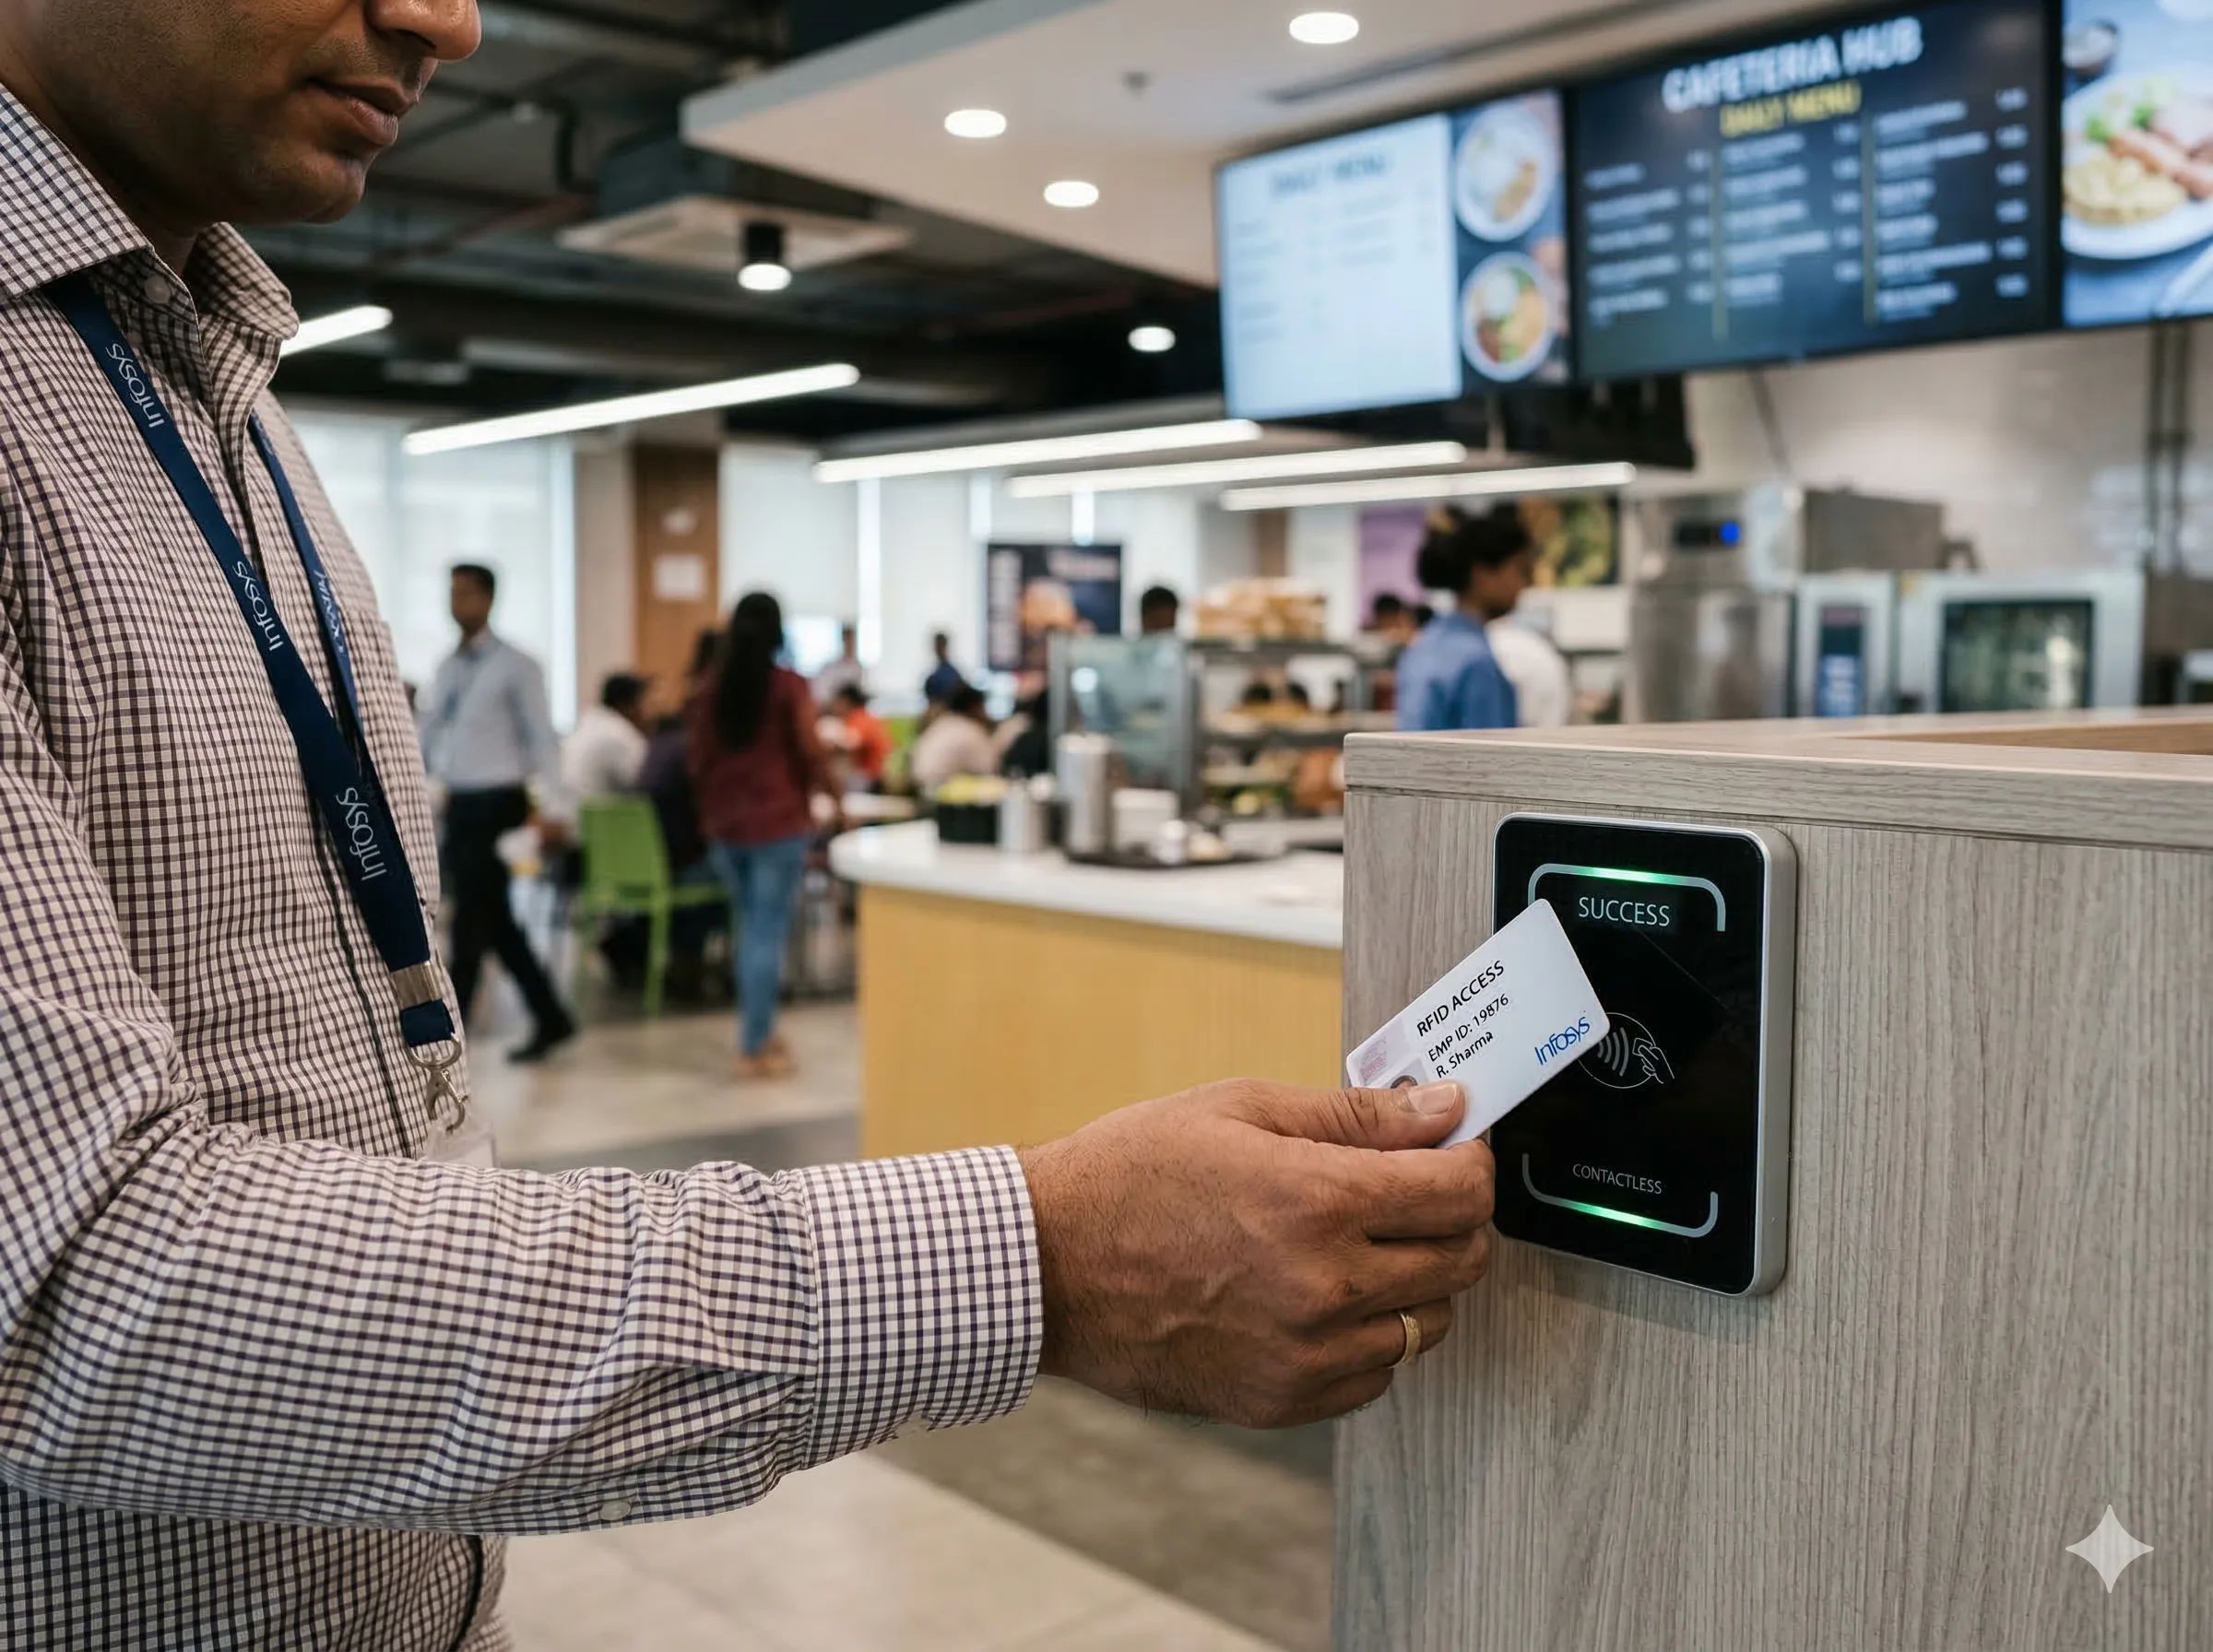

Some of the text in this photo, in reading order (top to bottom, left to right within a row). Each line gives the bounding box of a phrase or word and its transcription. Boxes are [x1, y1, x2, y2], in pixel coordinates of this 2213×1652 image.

[1663, 17, 1923, 112] CAFETERIA HUB
[1786, 78, 1861, 122] MENU
[105, 343, 165, 428] Infosys
[231, 560, 284, 651] Infosys
[335, 787, 387, 880] Infosys
[1579, 896, 1670, 926] SUCCESS
[1416, 960, 1505, 1037] RFID ACCESS
[1428, 993, 1509, 1062] EMP ID: 19876
[1436, 1030, 1494, 1079] R. Sharma
[1534, 1016, 1591, 1066] Infosys
[1572, 1163, 1662, 1194] CONTACTLESS
